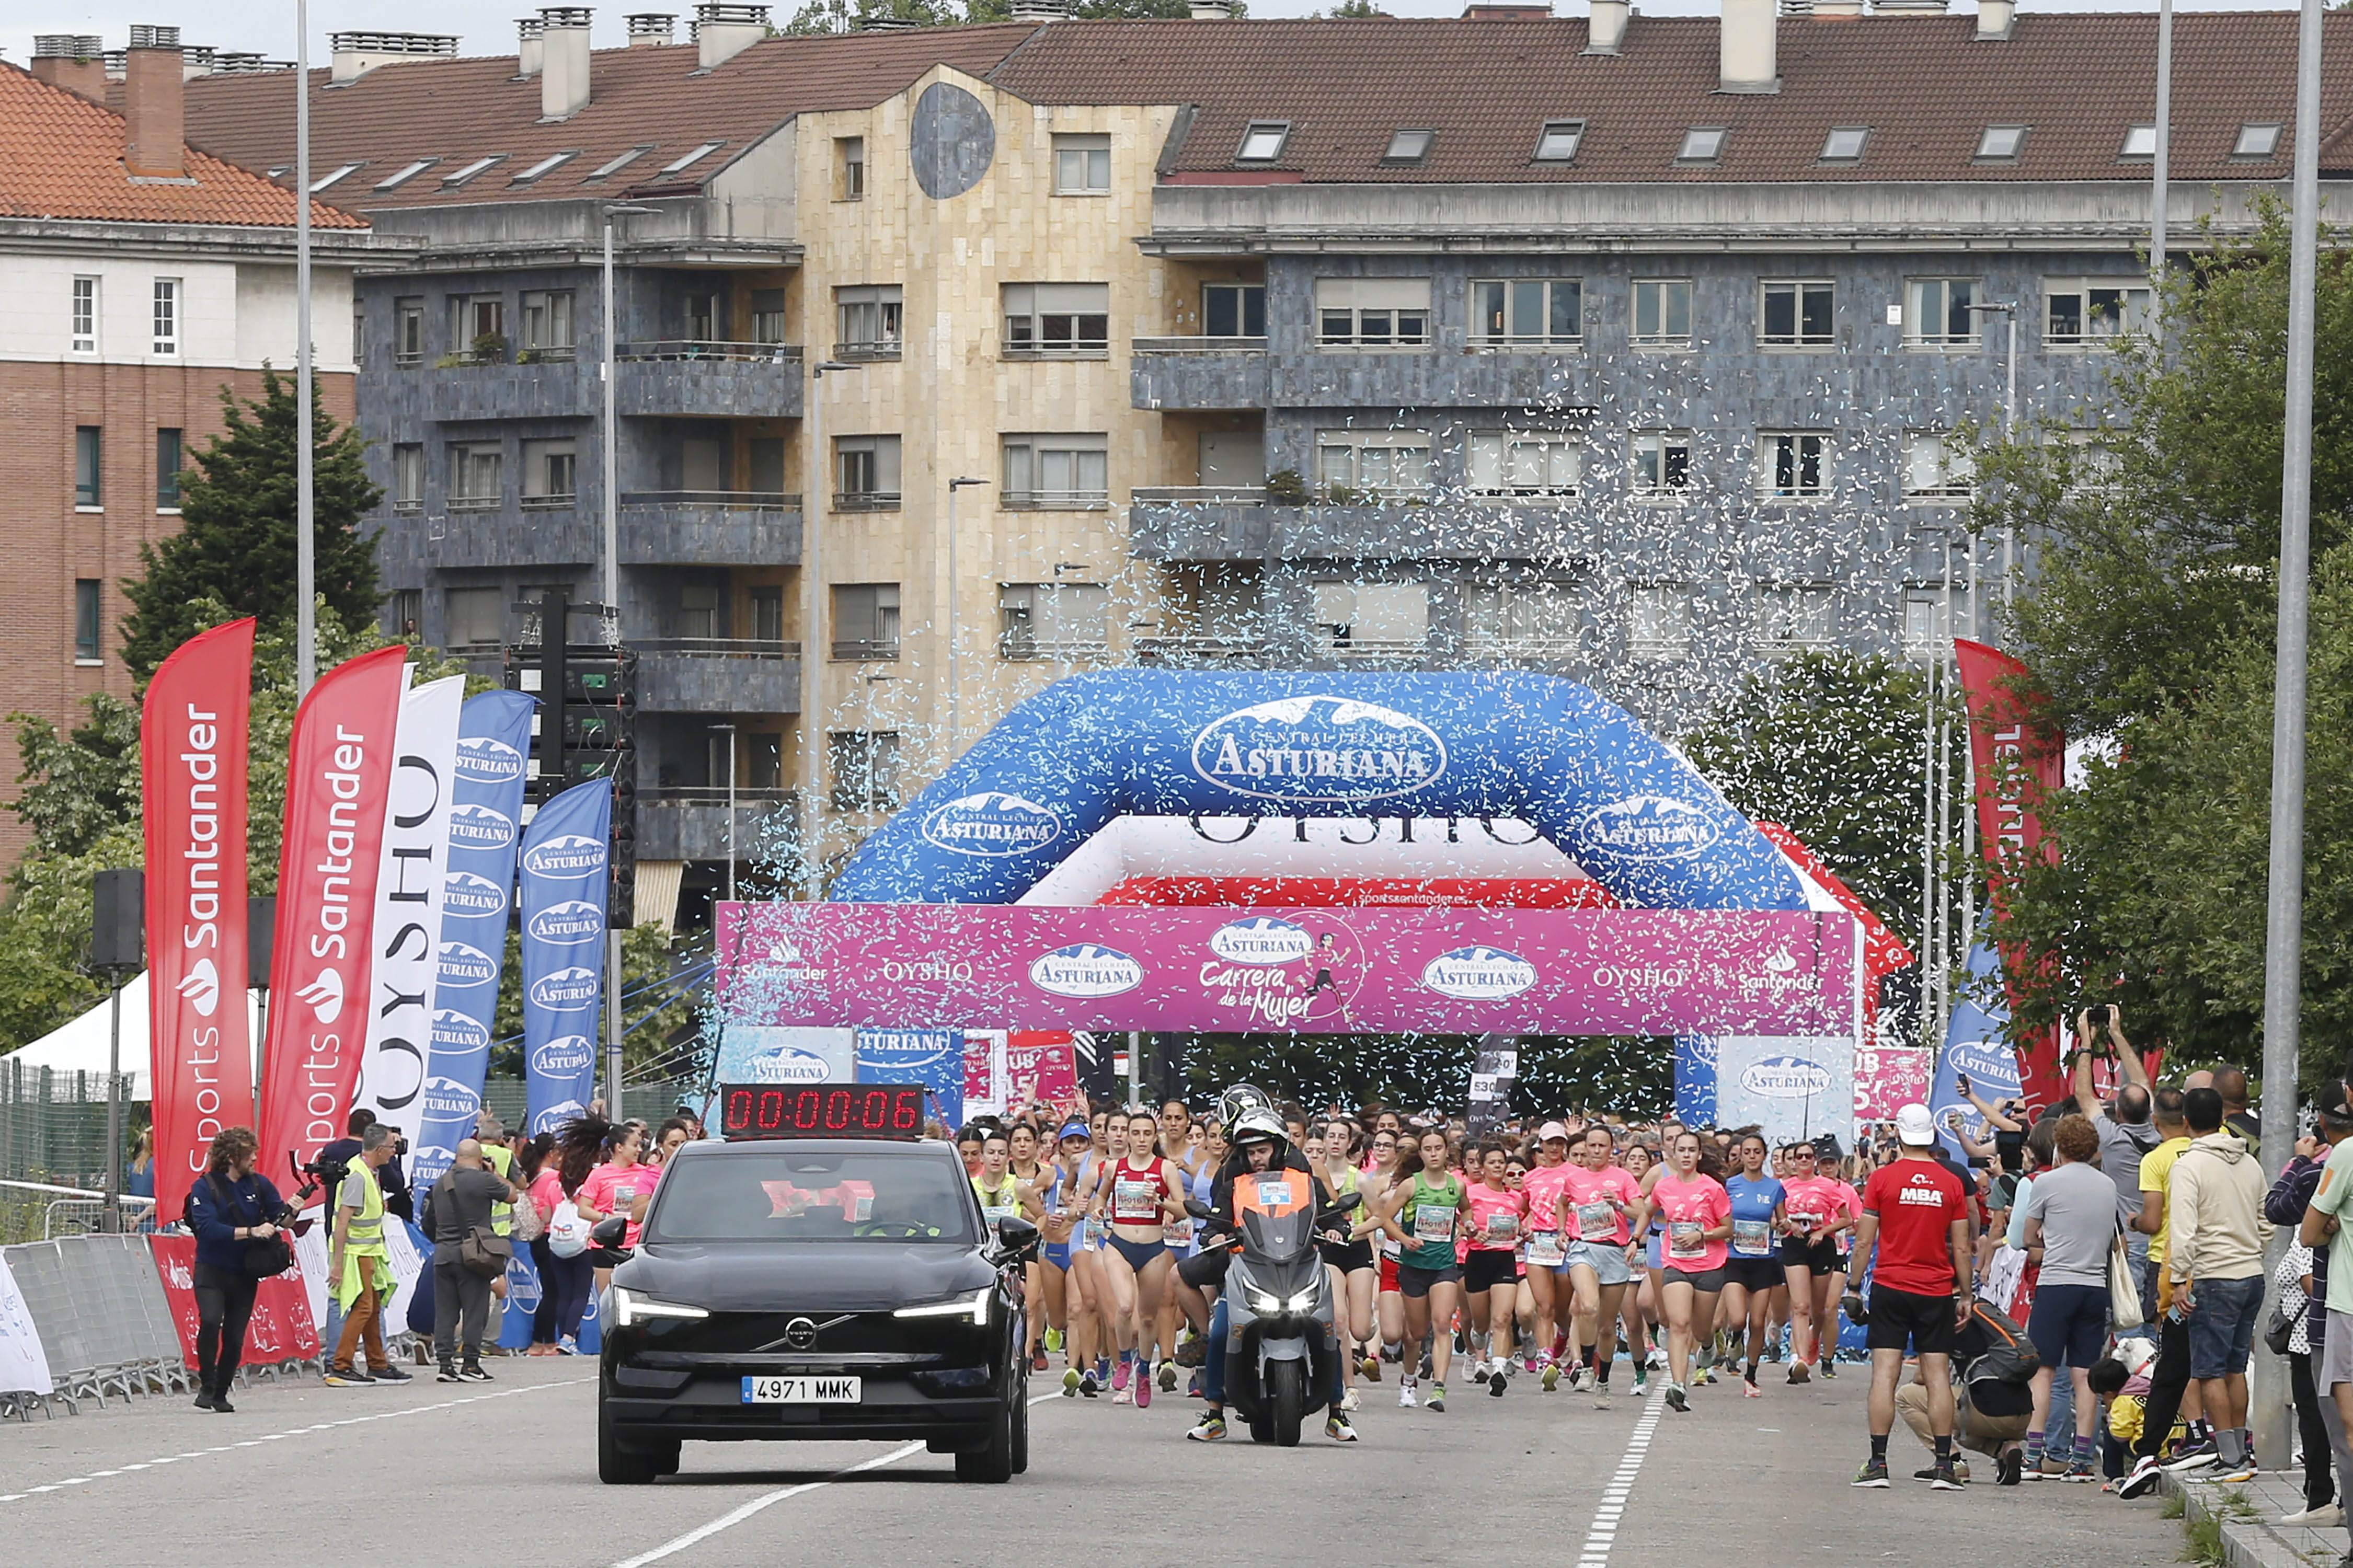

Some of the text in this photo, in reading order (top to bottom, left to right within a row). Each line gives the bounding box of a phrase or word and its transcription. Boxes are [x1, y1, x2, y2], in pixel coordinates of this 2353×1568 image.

[456, 755, 517, 774] STURIANA
[1211, 732, 1428, 778] ASTURIANA
[180, 703, 220, 949] Santander
[451, 823, 509, 841] TURIANA
[931, 813, 1049, 840] ASTURIANA
[311, 724, 364, 960] Santander
[443, 892, 498, 909] TURIANA
[376, 755, 440, 1110] OYSHO
[1218, 934, 1305, 952] ASTURIANA
[437, 962, 489, 978] TURIANA
[884, 962, 973, 982] OYSHO
[1039, 962, 1134, 984] ASTURIANA
[1199, 961, 1286, 987] Carrera
[1431, 965, 1527, 986] ASTURIANA
[1593, 967, 1684, 986] OYSHO
[1220, 985, 1317, 1027] de la Mujer
[430, 1029, 481, 1046] TURIANA
[857, 1033, 944, 1051] TURIANA
[1008, 1053, 1036, 1070] UB
[1953, 1049, 2022, 1085] ASTURIAN
[757, 1067, 824, 1079] STURIANA
[1747, 1071, 1824, 1088] ASTURIANA
[422, 1097, 473, 1113] TURIANA
[727, 1090, 917, 1129] 00:00:06
[1899, 1187, 1943, 1203] MBA
[757, 1380, 854, 1399] 4971 MMK
